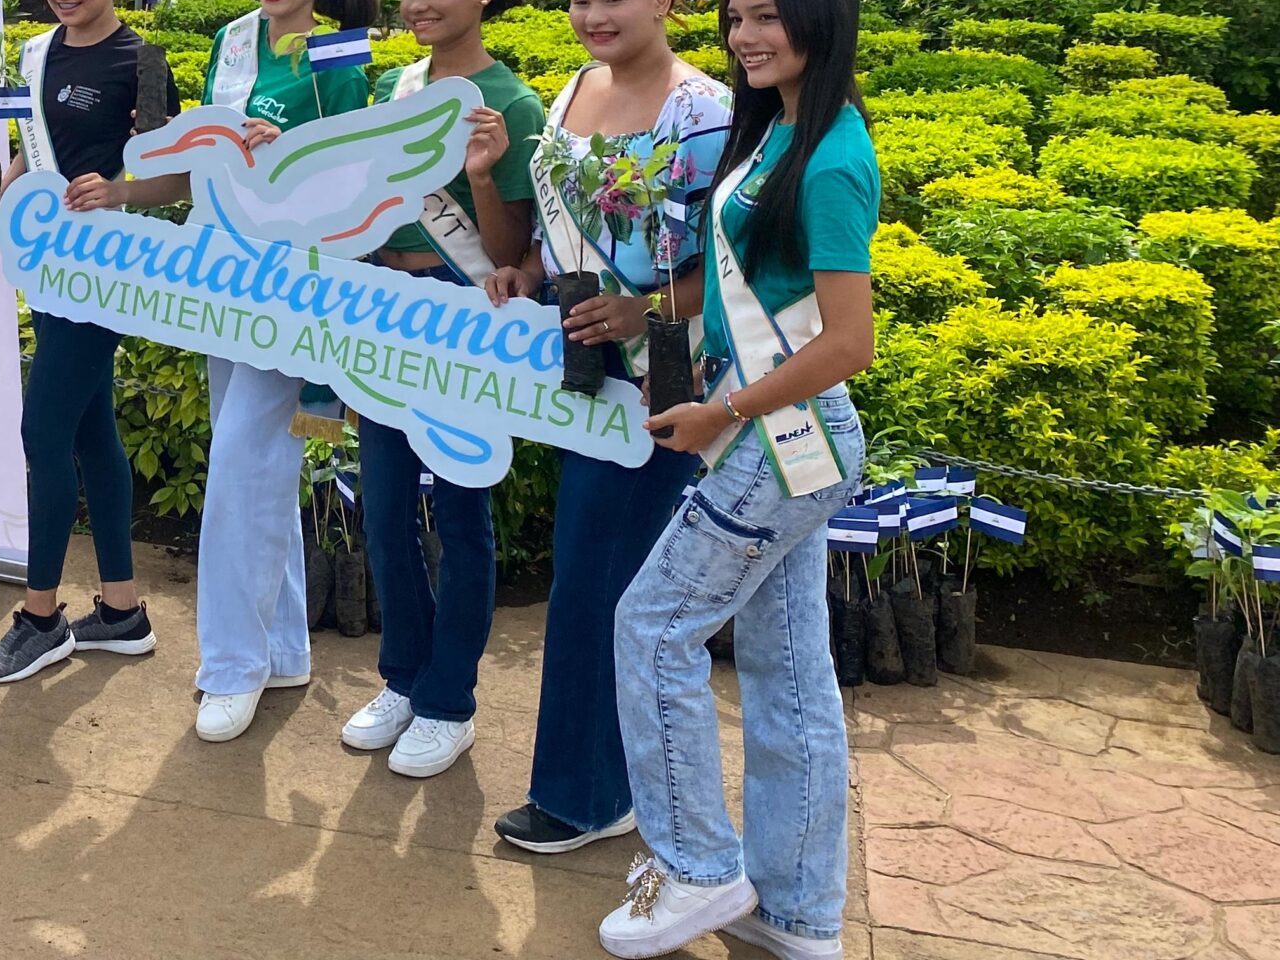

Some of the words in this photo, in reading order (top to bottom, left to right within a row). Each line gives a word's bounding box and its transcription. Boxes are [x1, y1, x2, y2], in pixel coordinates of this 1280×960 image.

[25, 117, 44, 172] Managu
[252, 95, 285, 117] UAM
[10, 188, 564, 373] Guardabarranco
[40, 263, 278, 350] MOVIMIENTO
[290, 325, 631, 443] AMBIENTALISTA
